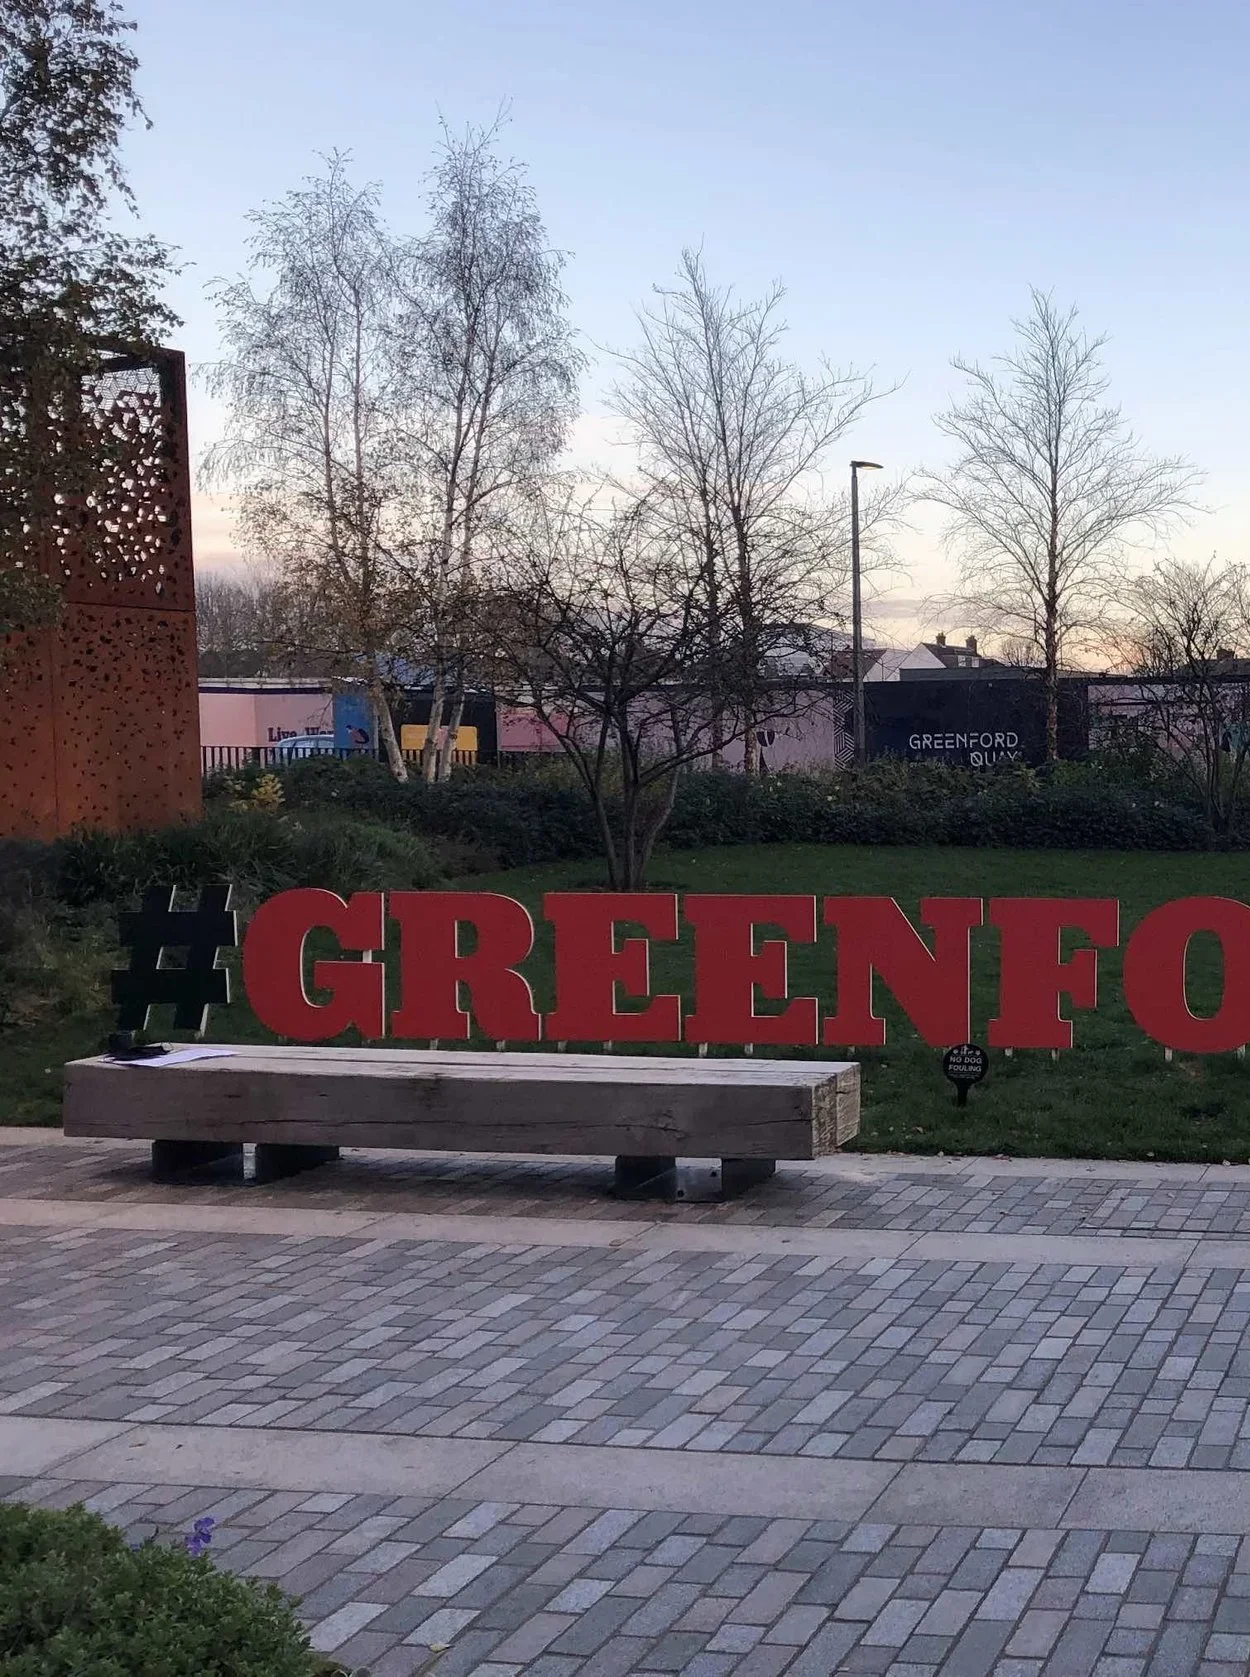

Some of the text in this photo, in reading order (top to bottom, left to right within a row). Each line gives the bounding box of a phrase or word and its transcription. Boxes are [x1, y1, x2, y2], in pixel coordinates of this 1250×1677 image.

[909, 732, 1019, 749] GREENFORD
[964, 1056, 982, 1064] DOG
[948, 1064, 982, 1072] FOULING
